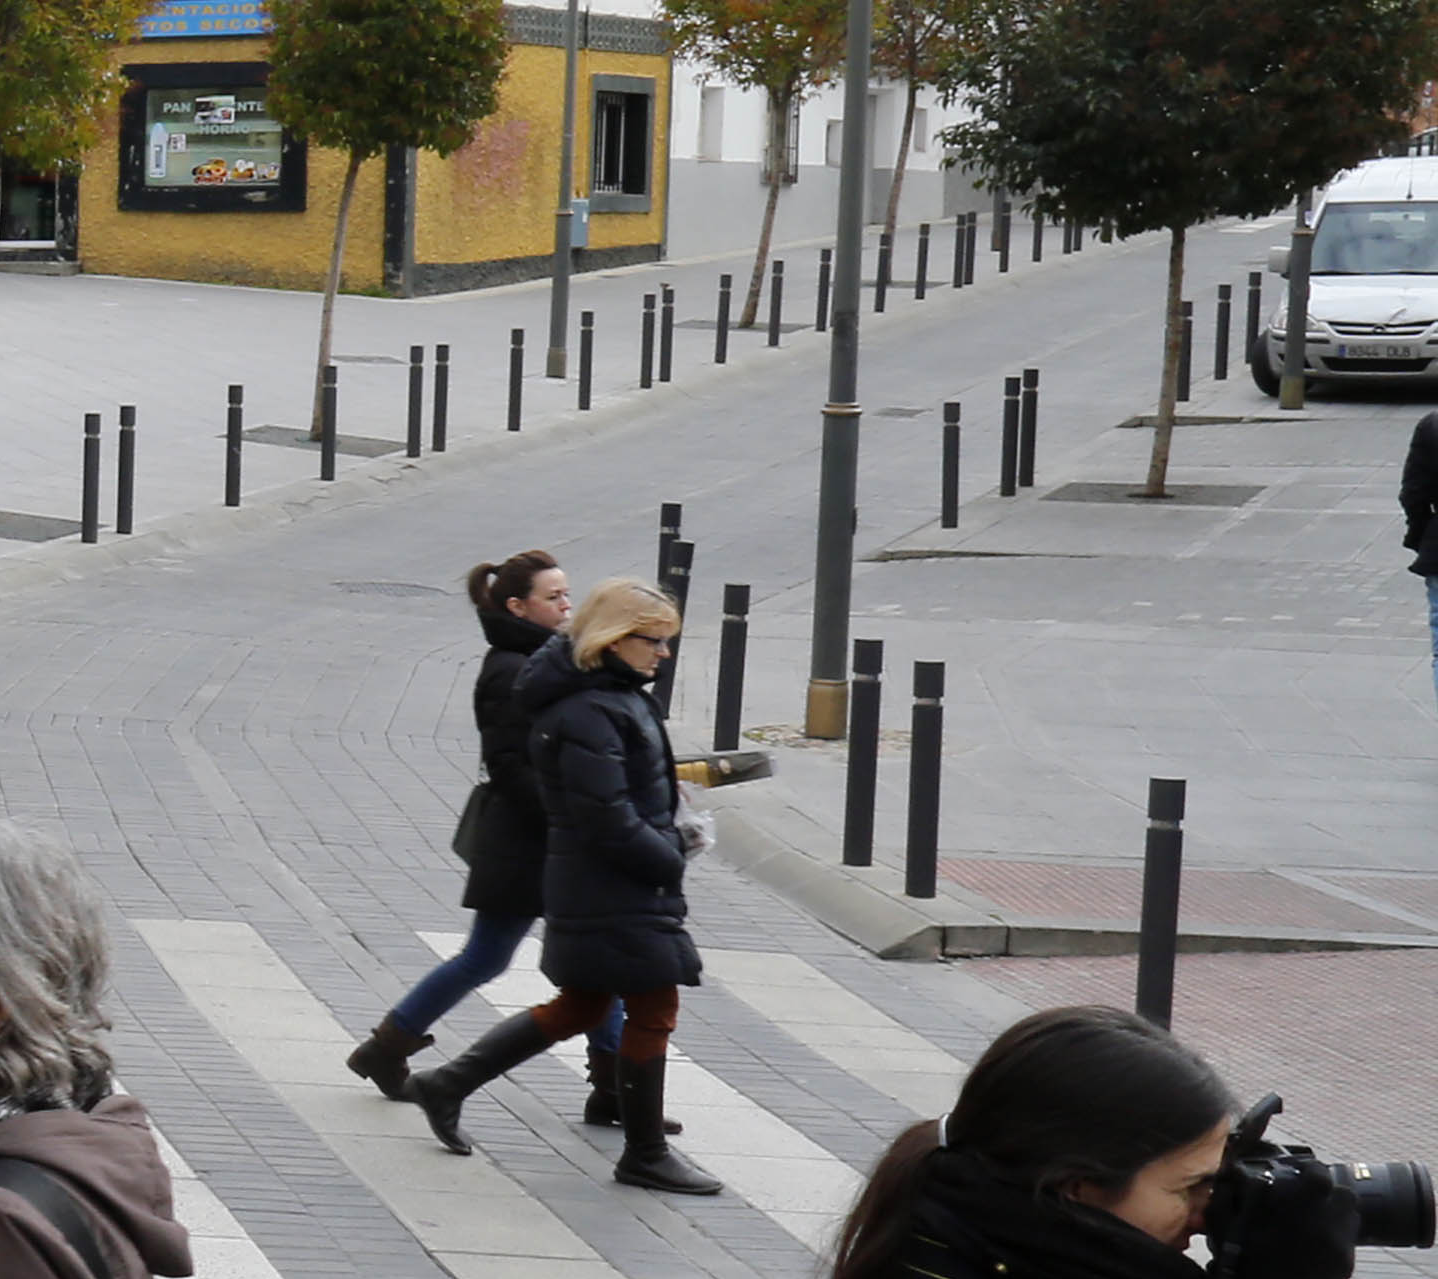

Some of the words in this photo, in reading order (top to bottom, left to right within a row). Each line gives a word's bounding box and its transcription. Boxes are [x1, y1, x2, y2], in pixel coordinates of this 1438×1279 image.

[147, 21, 188, 32] TOS
[199, 17, 273, 32] SECOS
[162, 101, 192, 113] PAN
